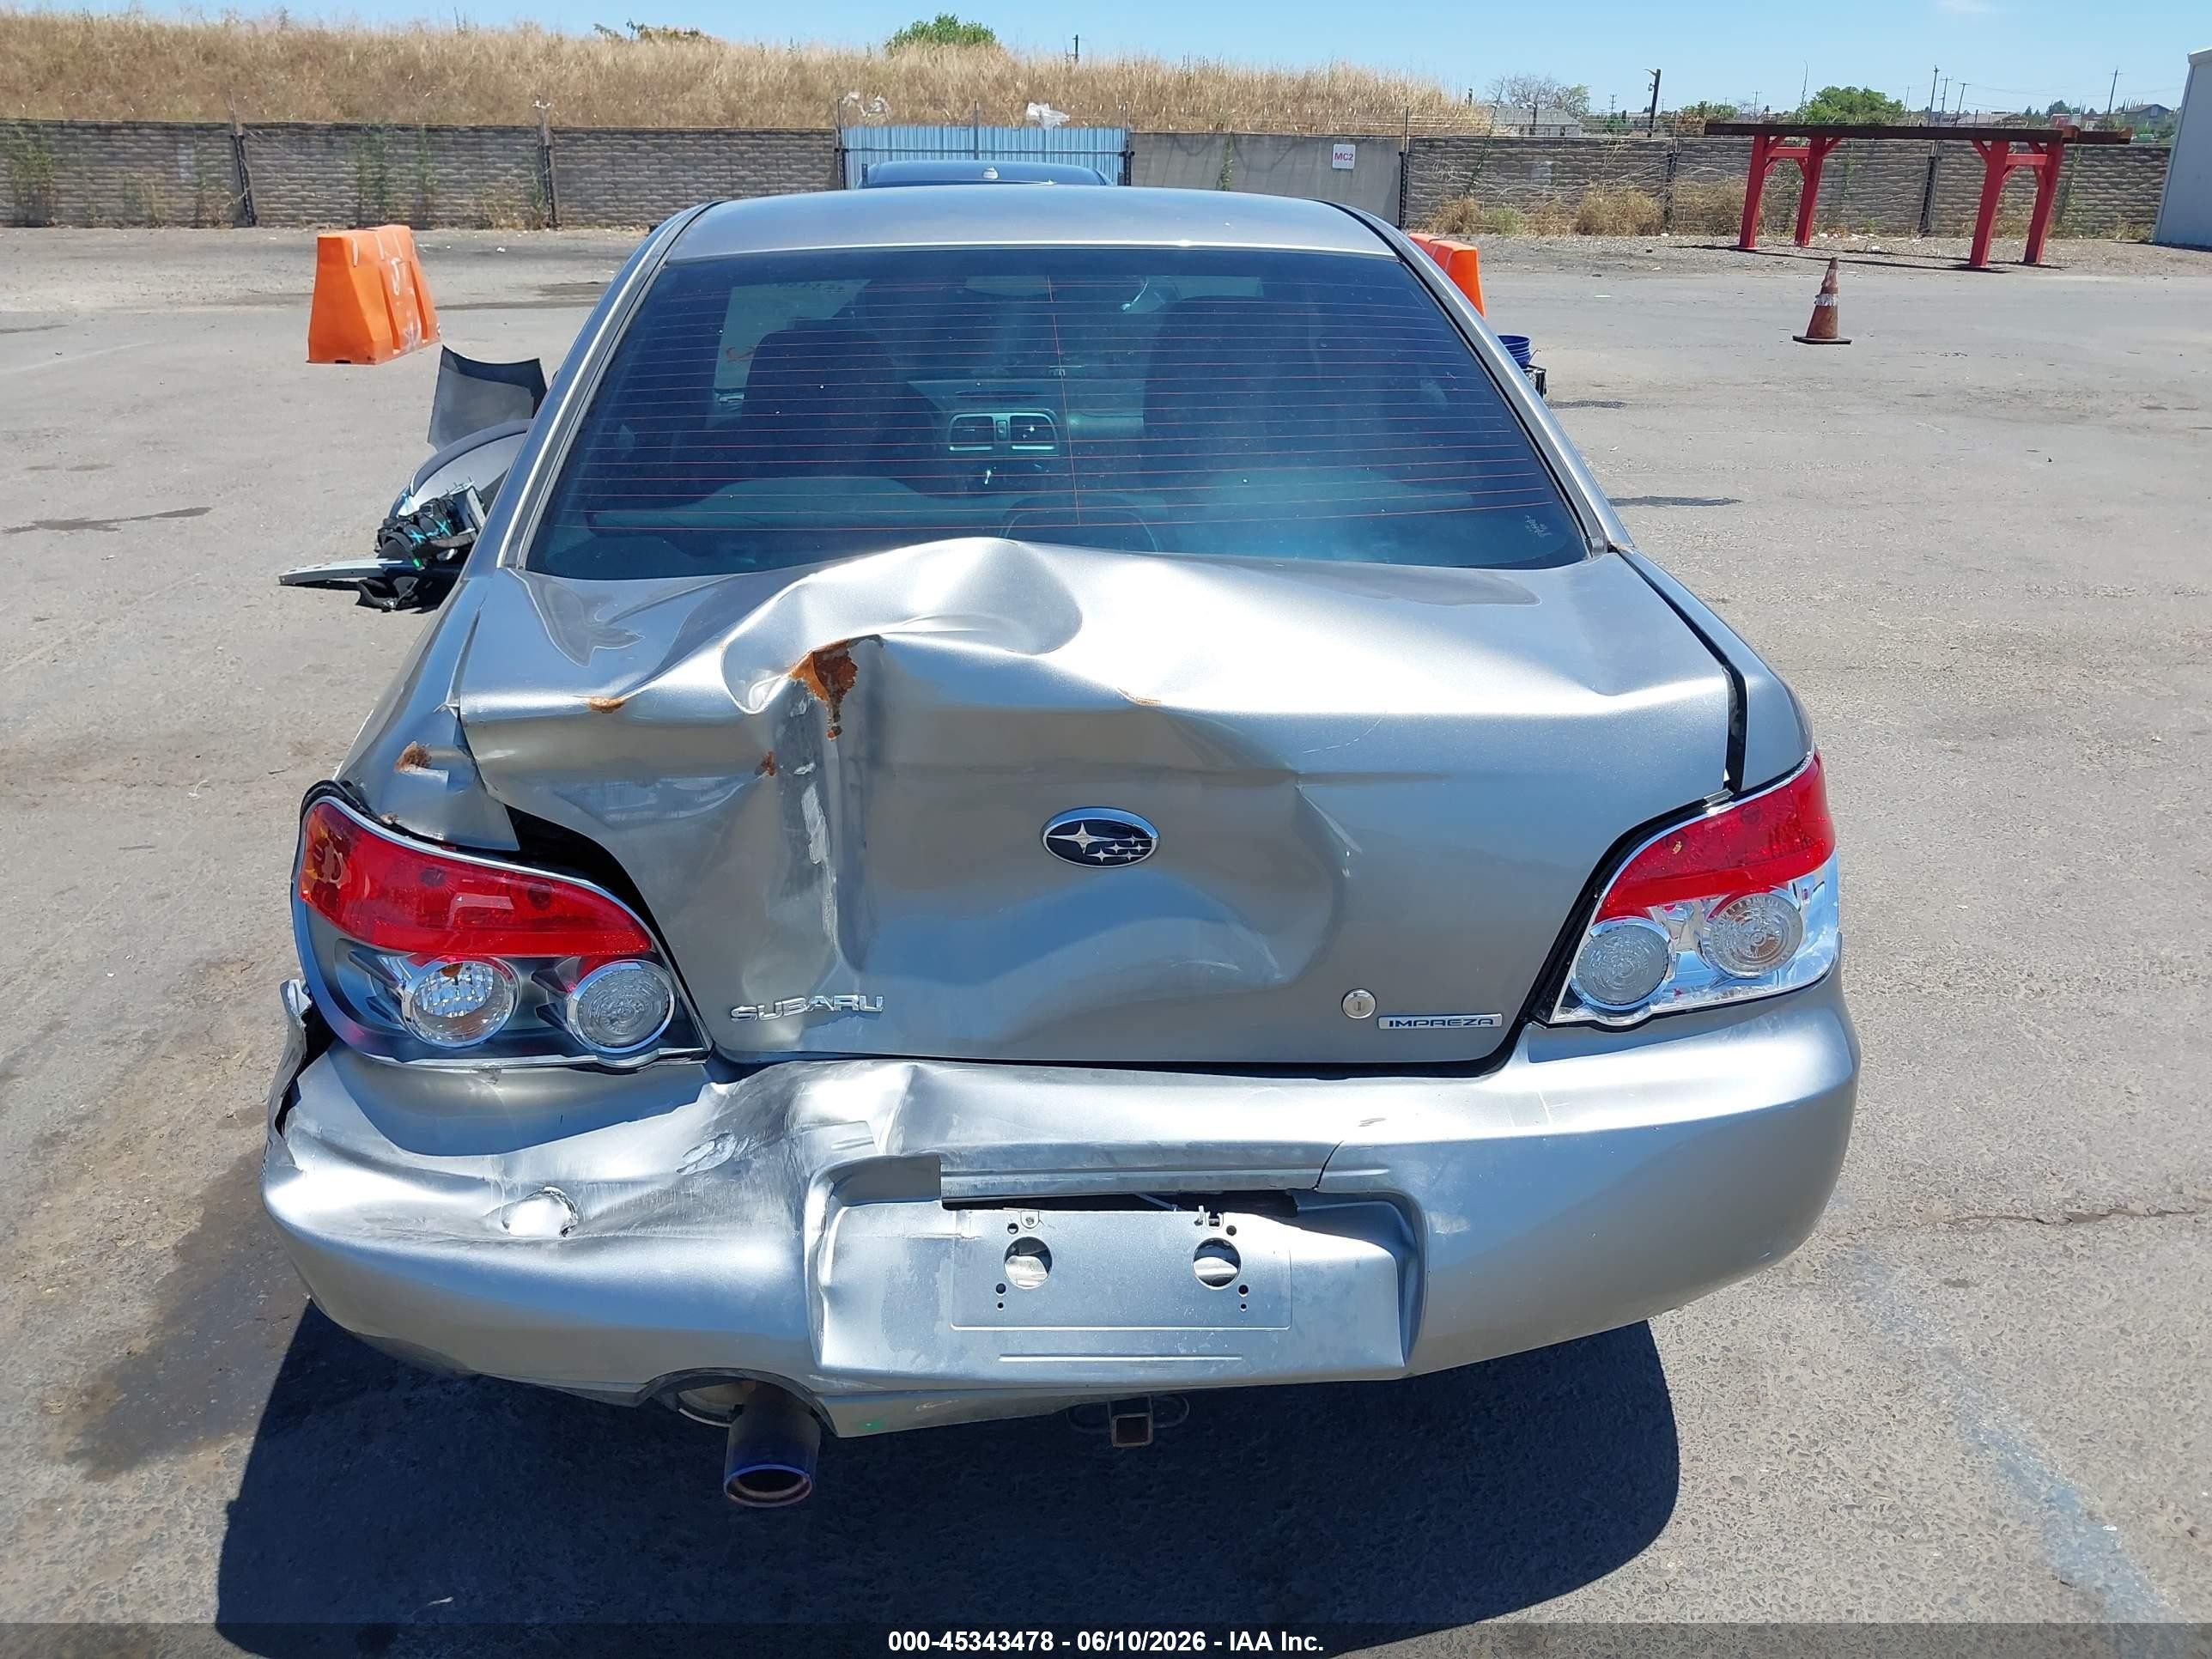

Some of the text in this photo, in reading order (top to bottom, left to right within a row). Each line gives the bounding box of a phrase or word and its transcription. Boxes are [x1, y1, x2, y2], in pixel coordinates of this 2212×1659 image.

[1334, 152, 1354, 161] MC2
[730, 994, 884, 1023] SUBARU
[1389, 1018, 1494, 1028] IMPREZA
